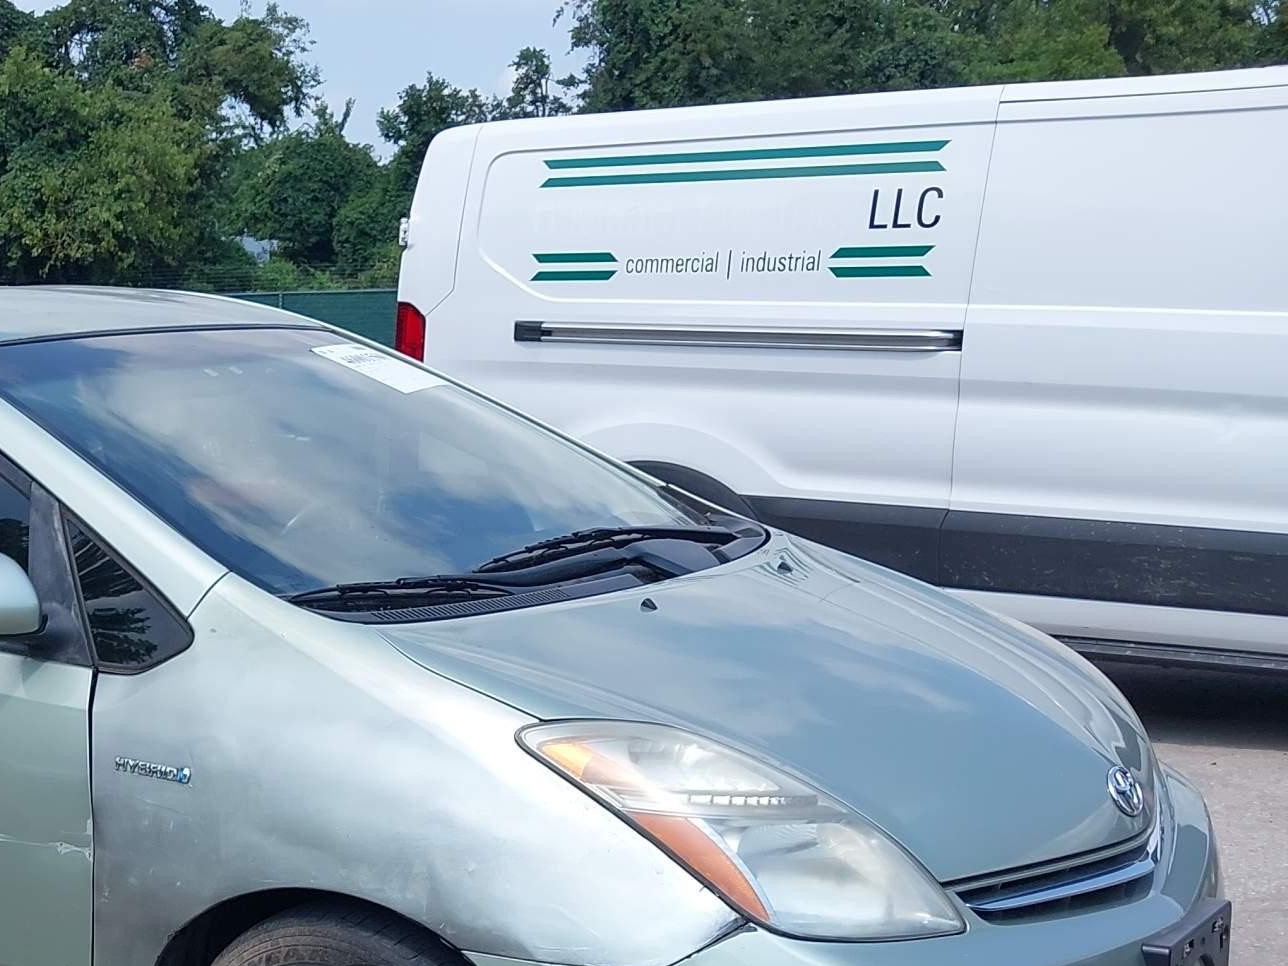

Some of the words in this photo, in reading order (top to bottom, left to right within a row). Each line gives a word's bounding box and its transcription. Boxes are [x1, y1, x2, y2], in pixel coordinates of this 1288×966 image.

[868, 186, 944, 229] LLC
[624, 251, 719, 275] commercial
[740, 249, 822, 273] industrial
[115, 757, 178, 782] HYBRID
